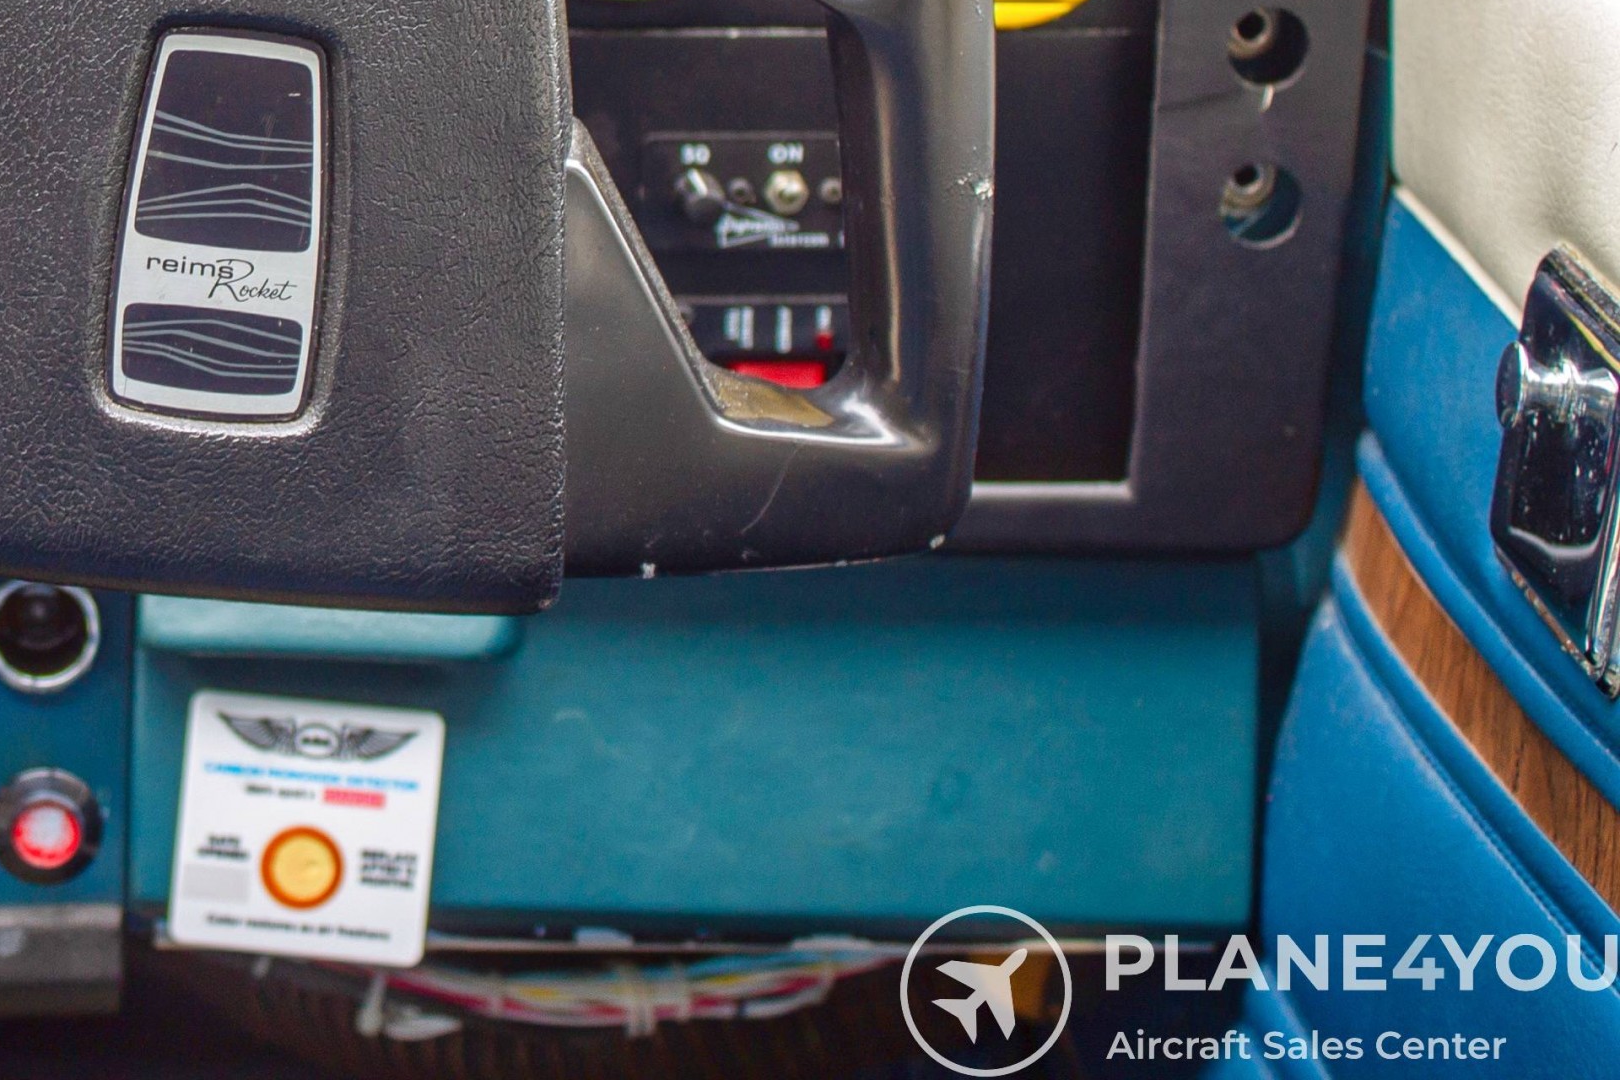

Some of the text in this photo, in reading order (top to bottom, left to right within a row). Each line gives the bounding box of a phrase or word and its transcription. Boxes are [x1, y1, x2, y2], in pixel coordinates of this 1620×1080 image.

[768, 143, 804, 164] ON
[146, 255, 234, 280] reims
[208, 259, 298, 303] Rocket
